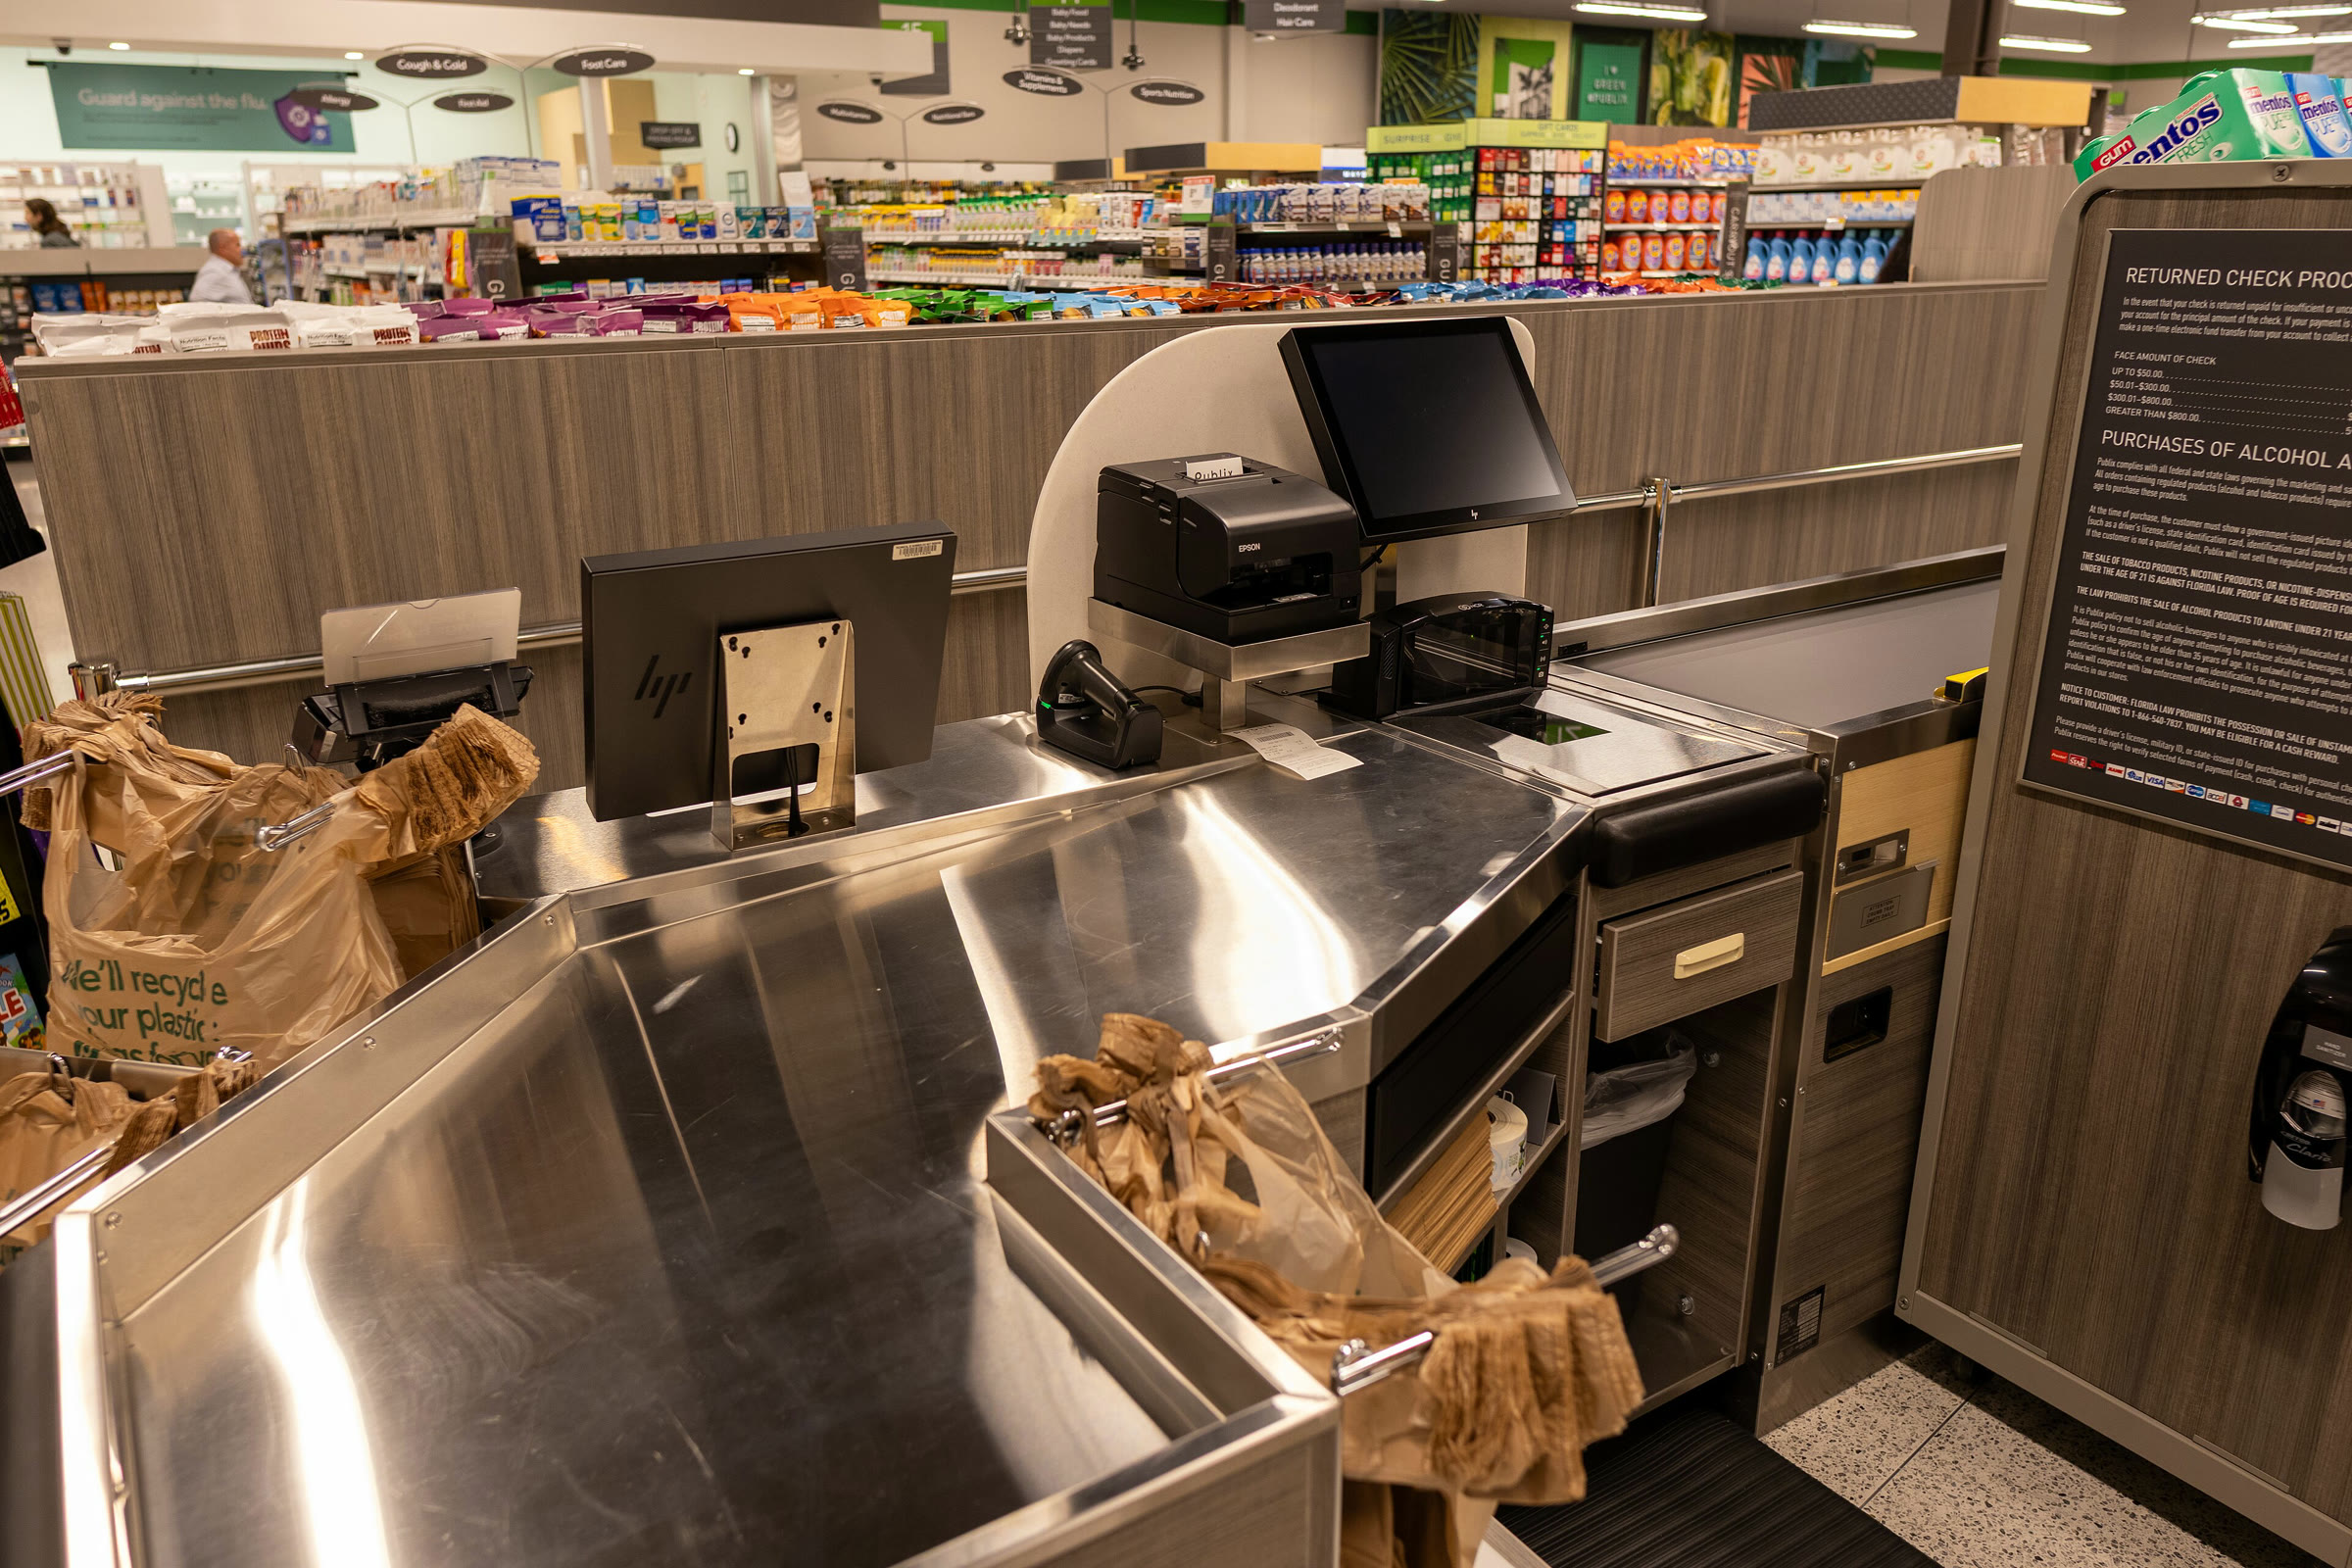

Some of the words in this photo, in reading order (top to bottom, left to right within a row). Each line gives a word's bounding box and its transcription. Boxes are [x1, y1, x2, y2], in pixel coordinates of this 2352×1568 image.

[1295, 17, 1315, 26] Care
[396, 60, 432, 73] Cough
[443, 59, 467, 71] Cold
[581, 59, 603, 70] Foot
[605, 58, 627, 68] Care
[77, 89, 133, 108] Guard
[140, 91, 206, 112] against
[209, 90, 238, 109] the
[2250, 96, 2292, 115] mentos
[2301, 100, 2339, 120] mentos
[2122, 101, 2222, 165] entos
[2176, 131, 2215, 163] FRESH
[2126, 267, 2221, 284] RETURNED
[2226, 270, 2292, 287] CHECK
[250, 328, 289, 342] PROTEIN
[373, 327, 410, 340] PROTEIN
[2114, 350, 2134, 360] FACE
[2135, 352, 2172, 362] AMOUNT
[2173, 354, 2184, 363] OF
[2185, 355, 2216, 365] CHECK
[2105, 406, 2141, 416] GREATER
[2143, 409, 2166, 418] THAN
[2101, 429, 2204, 454] PURCHASES
[2210, 440, 2234, 457] OF
[2237, 444, 2332, 467] ALCOHOL
[1239, 543, 1261, 554] EPSON
[2082, 551, 2094, 561] THE
[2094, 553, 2111, 564] SALE
[2111, 556, 2120, 564] OF
[2121, 557, 2151, 569] TOBACCO
[2151, 562, 2188, 576] PRODUCTS,
[2189, 568, 2223, 581] NICOTINE
[2224, 573, 2264, 589] PRODUCTS,
[2266, 580, 2277, 590] OR
[2080, 563, 2101, 573] UNDER
[2102, 565, 2115, 575] THE
[2114, 568, 2129, 578] AGE
[2129, 570, 2137, 579] OF
[2138, 572, 2146, 581] 21
[2147, 573, 2155, 582] IS
[2155, 575, 2185, 587] AGAINST
[2185, 580, 2215, 593] FLORIDA
[2216, 585, 2234, 596] LAW.
[2235, 588, 2261, 600] PROOF
[2262, 592, 2272, 602] OF
[2272, 594, 2288, 605] AGE
[2289, 597, 2298, 606] IS
[2298, 598, 2338, 612] REQUIRED
[2077, 585, 2088, 595] THE
[2088, 587, 2104, 597] LAW
[2104, 590, 2138, 604] PROHIBITS
[2139, 596, 2152, 607] THE
[2152, 599, 2170, 610] SALE
[2170, 602, 2180, 611] OF
[2180, 604, 2211, 617] ALCOHOL
[2213, 610, 2251, 623] PRODUCTS
[2253, 615, 2263, 625] TO
[2263, 618, 2293, 631] ANYONE
[2294, 623, 2322, 635] UNDER
[2322, 628, 2332, 637] 21
[634, 654, 692, 718] hp
[2061, 682, 2082, 694] NOTICE
[2083, 687, 2092, 696] TO
[2092, 689, 2129, 705] CUSTOMER:
[2130, 698, 2158, 711] FLORIDA
[2158, 704, 2175, 714] LAW
[2175, 708, 2212, 723] PROHIBITS
[2213, 715, 2227, 726] THE
[2227, 719, 2273, 736] POSSESSION
[2274, 729, 2285, 739] OR
[2285, 732, 2305, 744] SALE
[2306, 736, 2317, 746] OF
[2059, 693, 2083, 706] REPORT
[2083, 699, 2121, 714] VIOLATIONS
[2122, 708, 2130, 716] TO
[2132, 710, 2182, 729] 1-866-540-7837.
[2185, 722, 2199, 732] YOU
[2199, 725, 2216, 736] MAY
[2216, 729, 2226, 738] BE
[2227, 731, 2258, 746] ELIGIBLE
[2258, 738, 2274, 749] FOR
[2274, 742, 2280, 751] A
[2281, 744, 2303, 756] CASH
[2303, 748, 2337, 763] REWARD.
[2146, 776, 2165, 786] VISA
[136, 1002, 205, 1043] plastic
